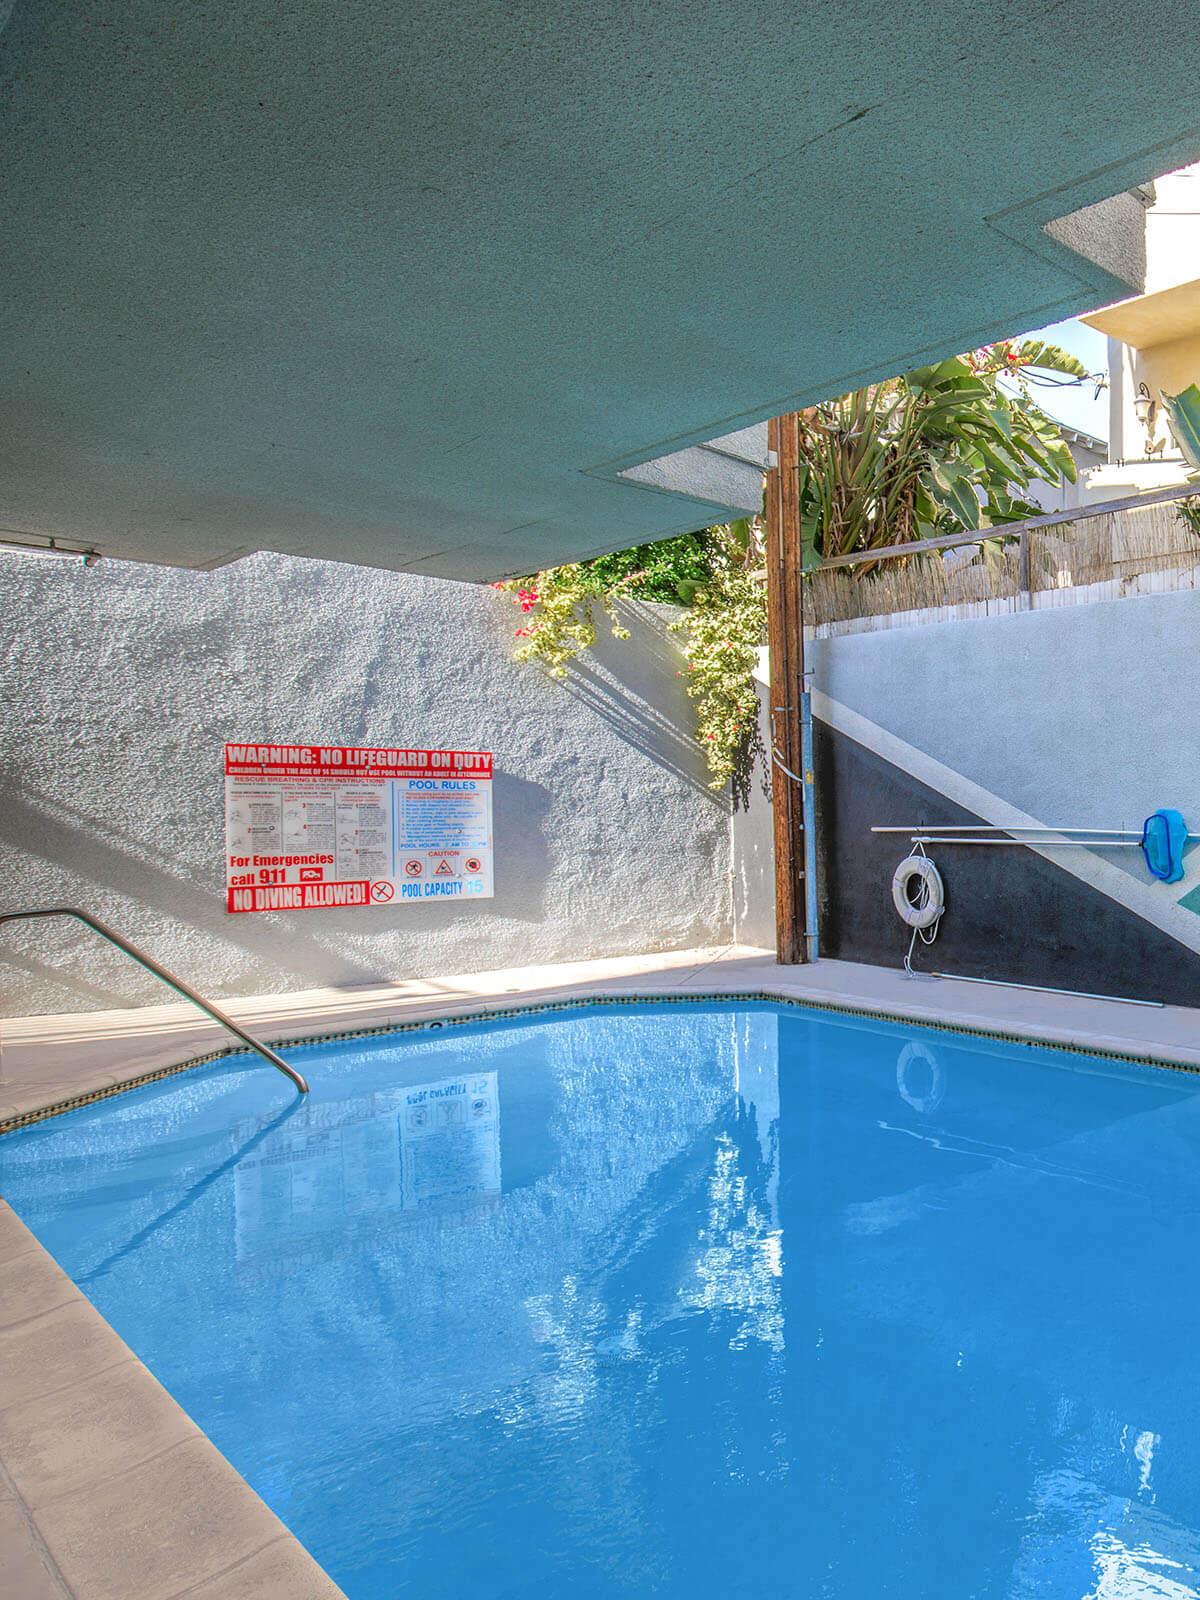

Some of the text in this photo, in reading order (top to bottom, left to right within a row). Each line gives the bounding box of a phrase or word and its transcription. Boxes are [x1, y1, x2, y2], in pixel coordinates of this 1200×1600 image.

[227, 746, 491, 769] WARNING: NO LIFEGUARD ON DUTY
[409, 780, 476, 790] POOL RULES
[230, 853, 334, 867] For Emergencies
[231, 868, 286, 886] call 911
[233, 883, 366, 911] NO DIVING ALLOWED!
[401, 880, 484, 897] POOL CAPACITY 15
